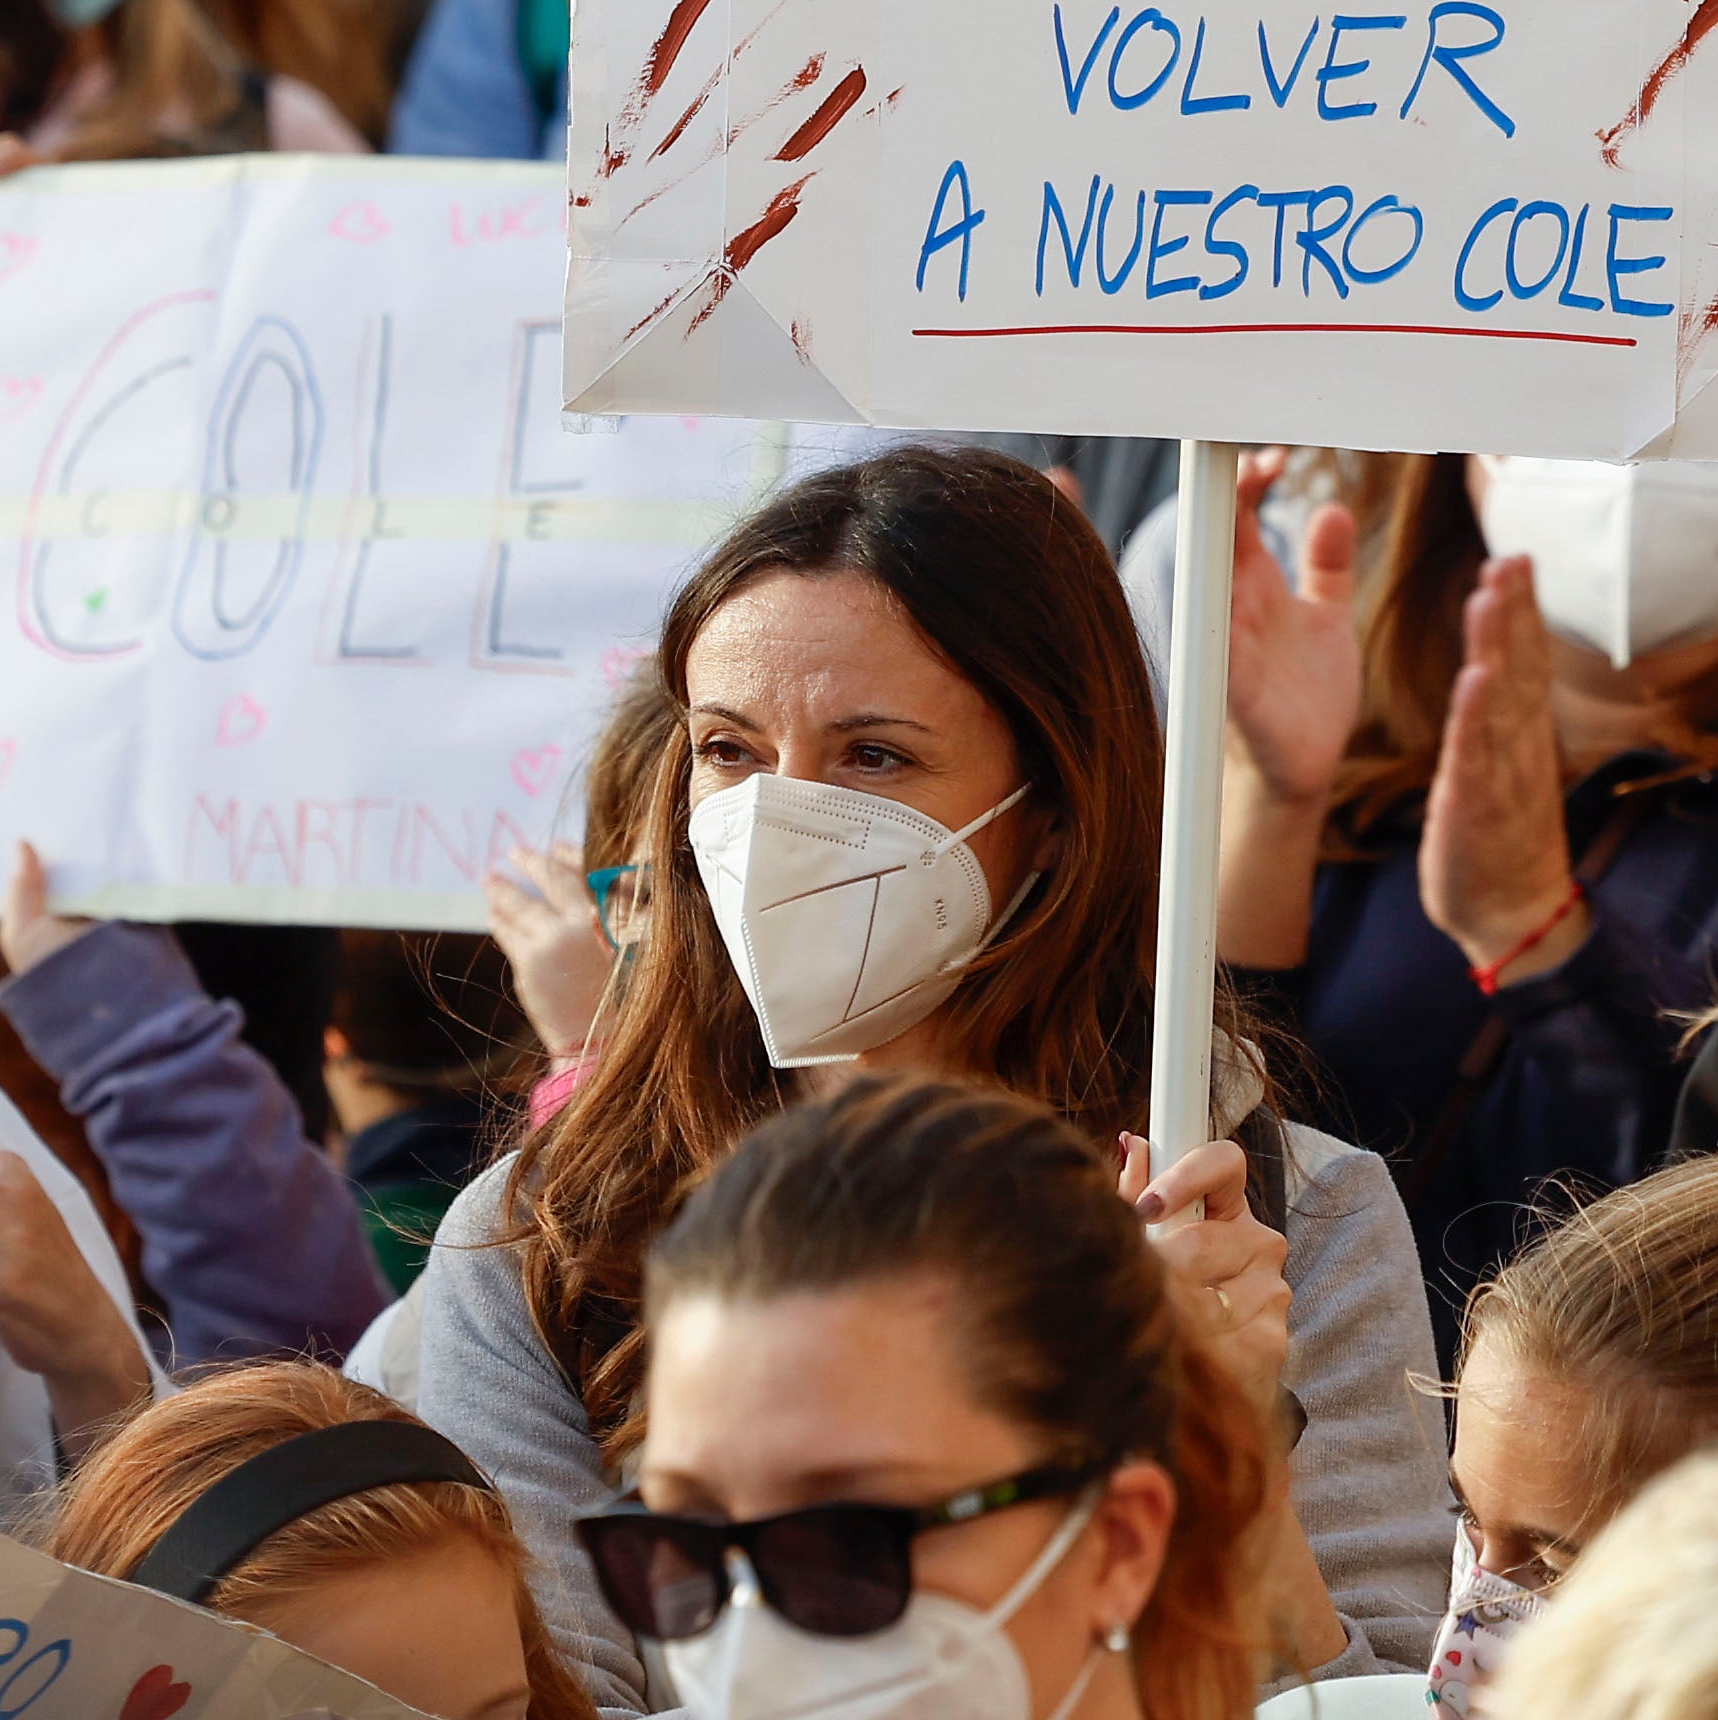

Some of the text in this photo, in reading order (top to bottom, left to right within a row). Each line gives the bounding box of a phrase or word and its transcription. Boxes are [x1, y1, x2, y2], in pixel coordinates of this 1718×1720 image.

[1052, 0, 1518, 140] VOLVER
[448, 195, 567, 248] LUC
[914, 158, 1677, 320] A NUESTRO COLE
